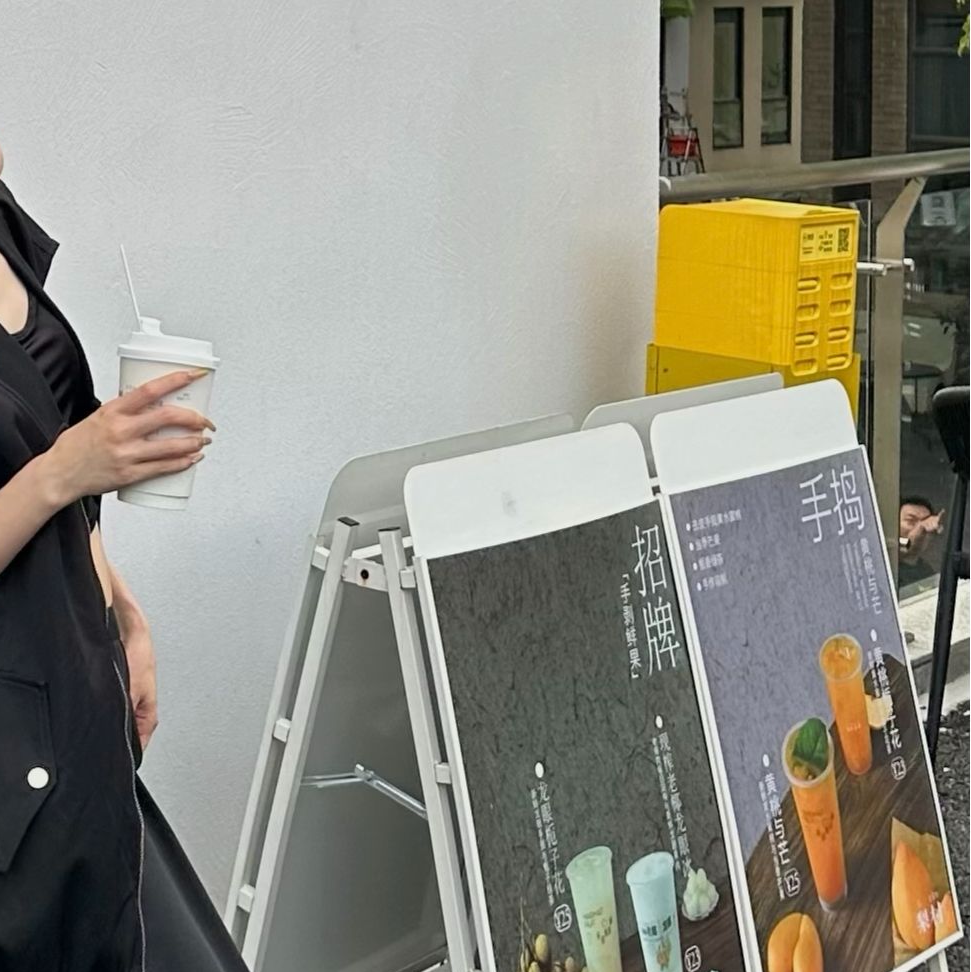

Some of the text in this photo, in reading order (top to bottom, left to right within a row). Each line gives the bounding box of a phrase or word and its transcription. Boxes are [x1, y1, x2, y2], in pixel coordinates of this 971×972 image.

[799, 464, 865, 543] 手捣
[631, 524, 680, 676] 招牌
[764, 772, 791, 866] 黄桃与芒
